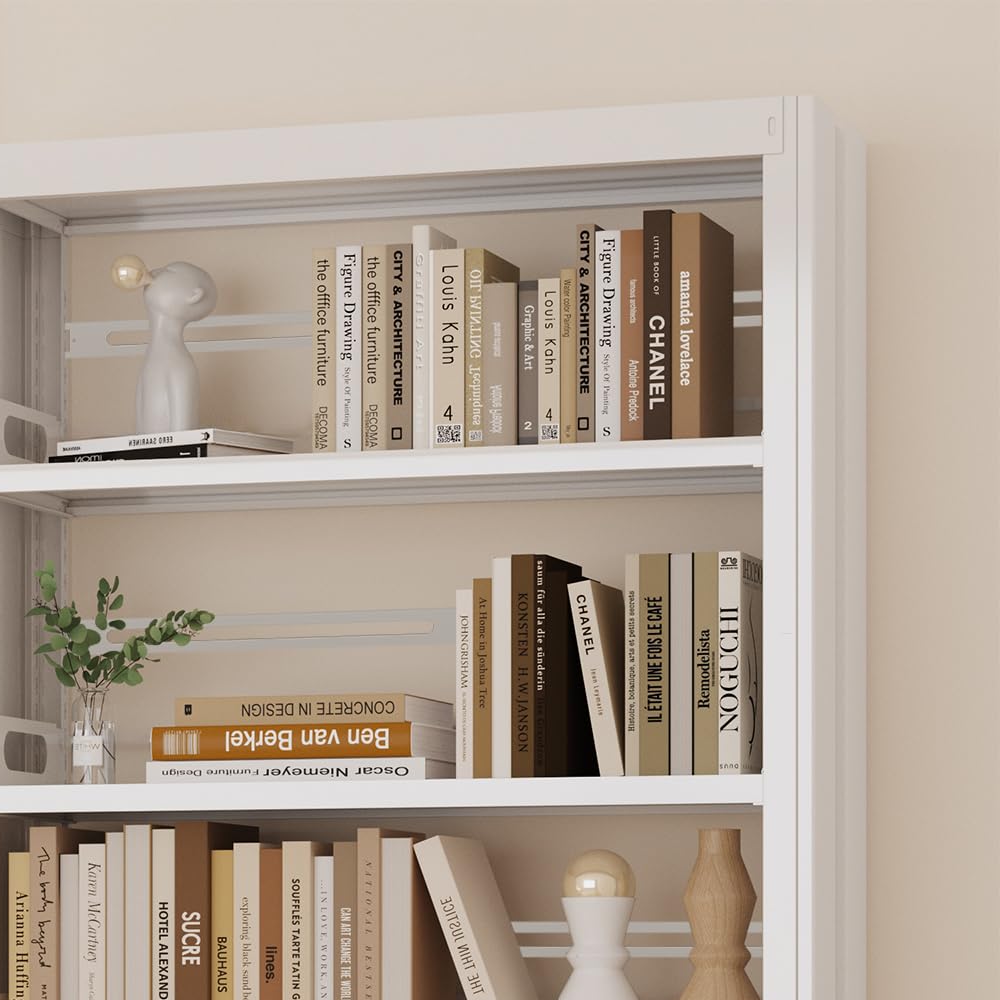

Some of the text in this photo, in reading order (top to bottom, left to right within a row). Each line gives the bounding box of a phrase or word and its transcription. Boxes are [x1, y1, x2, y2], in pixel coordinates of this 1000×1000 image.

[340, 254, 356, 360] Figure Drawing
[563, 279, 571, 297] Water
[600, 238, 615, 347] Figure Drawing
[654, 286, 659, 295] OF
[317, 260, 330, 386] the offfice furniture
[367, 257, 380, 384] the offfice furniture
[393, 250, 402, 405] CITY & ARCHITECTURE
[442, 265, 458, 365] Louis Kahn
[544, 291, 556, 374] Louis Kahn
[563, 314, 571, 337] Painting
[580, 230, 589, 393] CITY & ARCHITECTURE
[680, 271, 694, 386] amanda lovelace
[522, 305, 534, 370] Graphic & Art
[603, 373, 610, 382] Of
[649, 316, 665, 409] CHANEL
[628, 360, 639, 421] Antoine Predock
[319, 407, 327, 449] DECOMA
[369, 405, 378, 448] DECOMA
[525, 422, 531, 430] 2
[537, 590, 545, 604] für
[537, 607, 545, 625] alla
[518, 593, 528, 657] KONSTEN
[537, 628, 545, 643] die
[576, 594, 595, 655] CHANEL
[478, 597, 487, 708] At Home in Joshua Tree
[537, 646, 545, 691] sünderin
[645, 597, 662, 722] IL ÉTAIT UNE FOIS LE CAFÉ
[698, 629, 710, 709] Remodelista
[720, 607, 739, 732] NOGUCHI
[628, 664, 636, 700] botanique,
[241, 701, 395, 716] CONCRETE IN DESIGN
[226, 728, 389, 751] Ben van Berkel
[162, 766, 409, 777] Oscar Niemeyer Furniture Design
[37, 847, 50, 877] The
[88, 863, 100, 897] Karen
[37, 882, 53, 912] body
[292, 879, 302, 925] SOUFFLÉS
[340, 908, 351, 921] CAN
[16, 891, 28, 946] Arianna
[83, 901, 101, 962] McCartney
[159, 902, 168, 940] HOTEL
[182, 912, 201, 965] SUCRE
[240, 897, 251, 940] exploring
[341, 923, 351, 935] ART
[218, 937, 227, 992] BAUHAUS
[242, 943, 251, 967] black
[292, 929, 300, 958] TARTE
[341, 938, 351, 964] CHANGE
[242, 970, 251, 990] sand
[265, 946, 277, 984] lines.
[292, 961, 300, 989] TATIN
[341, 967, 351, 978] THE
